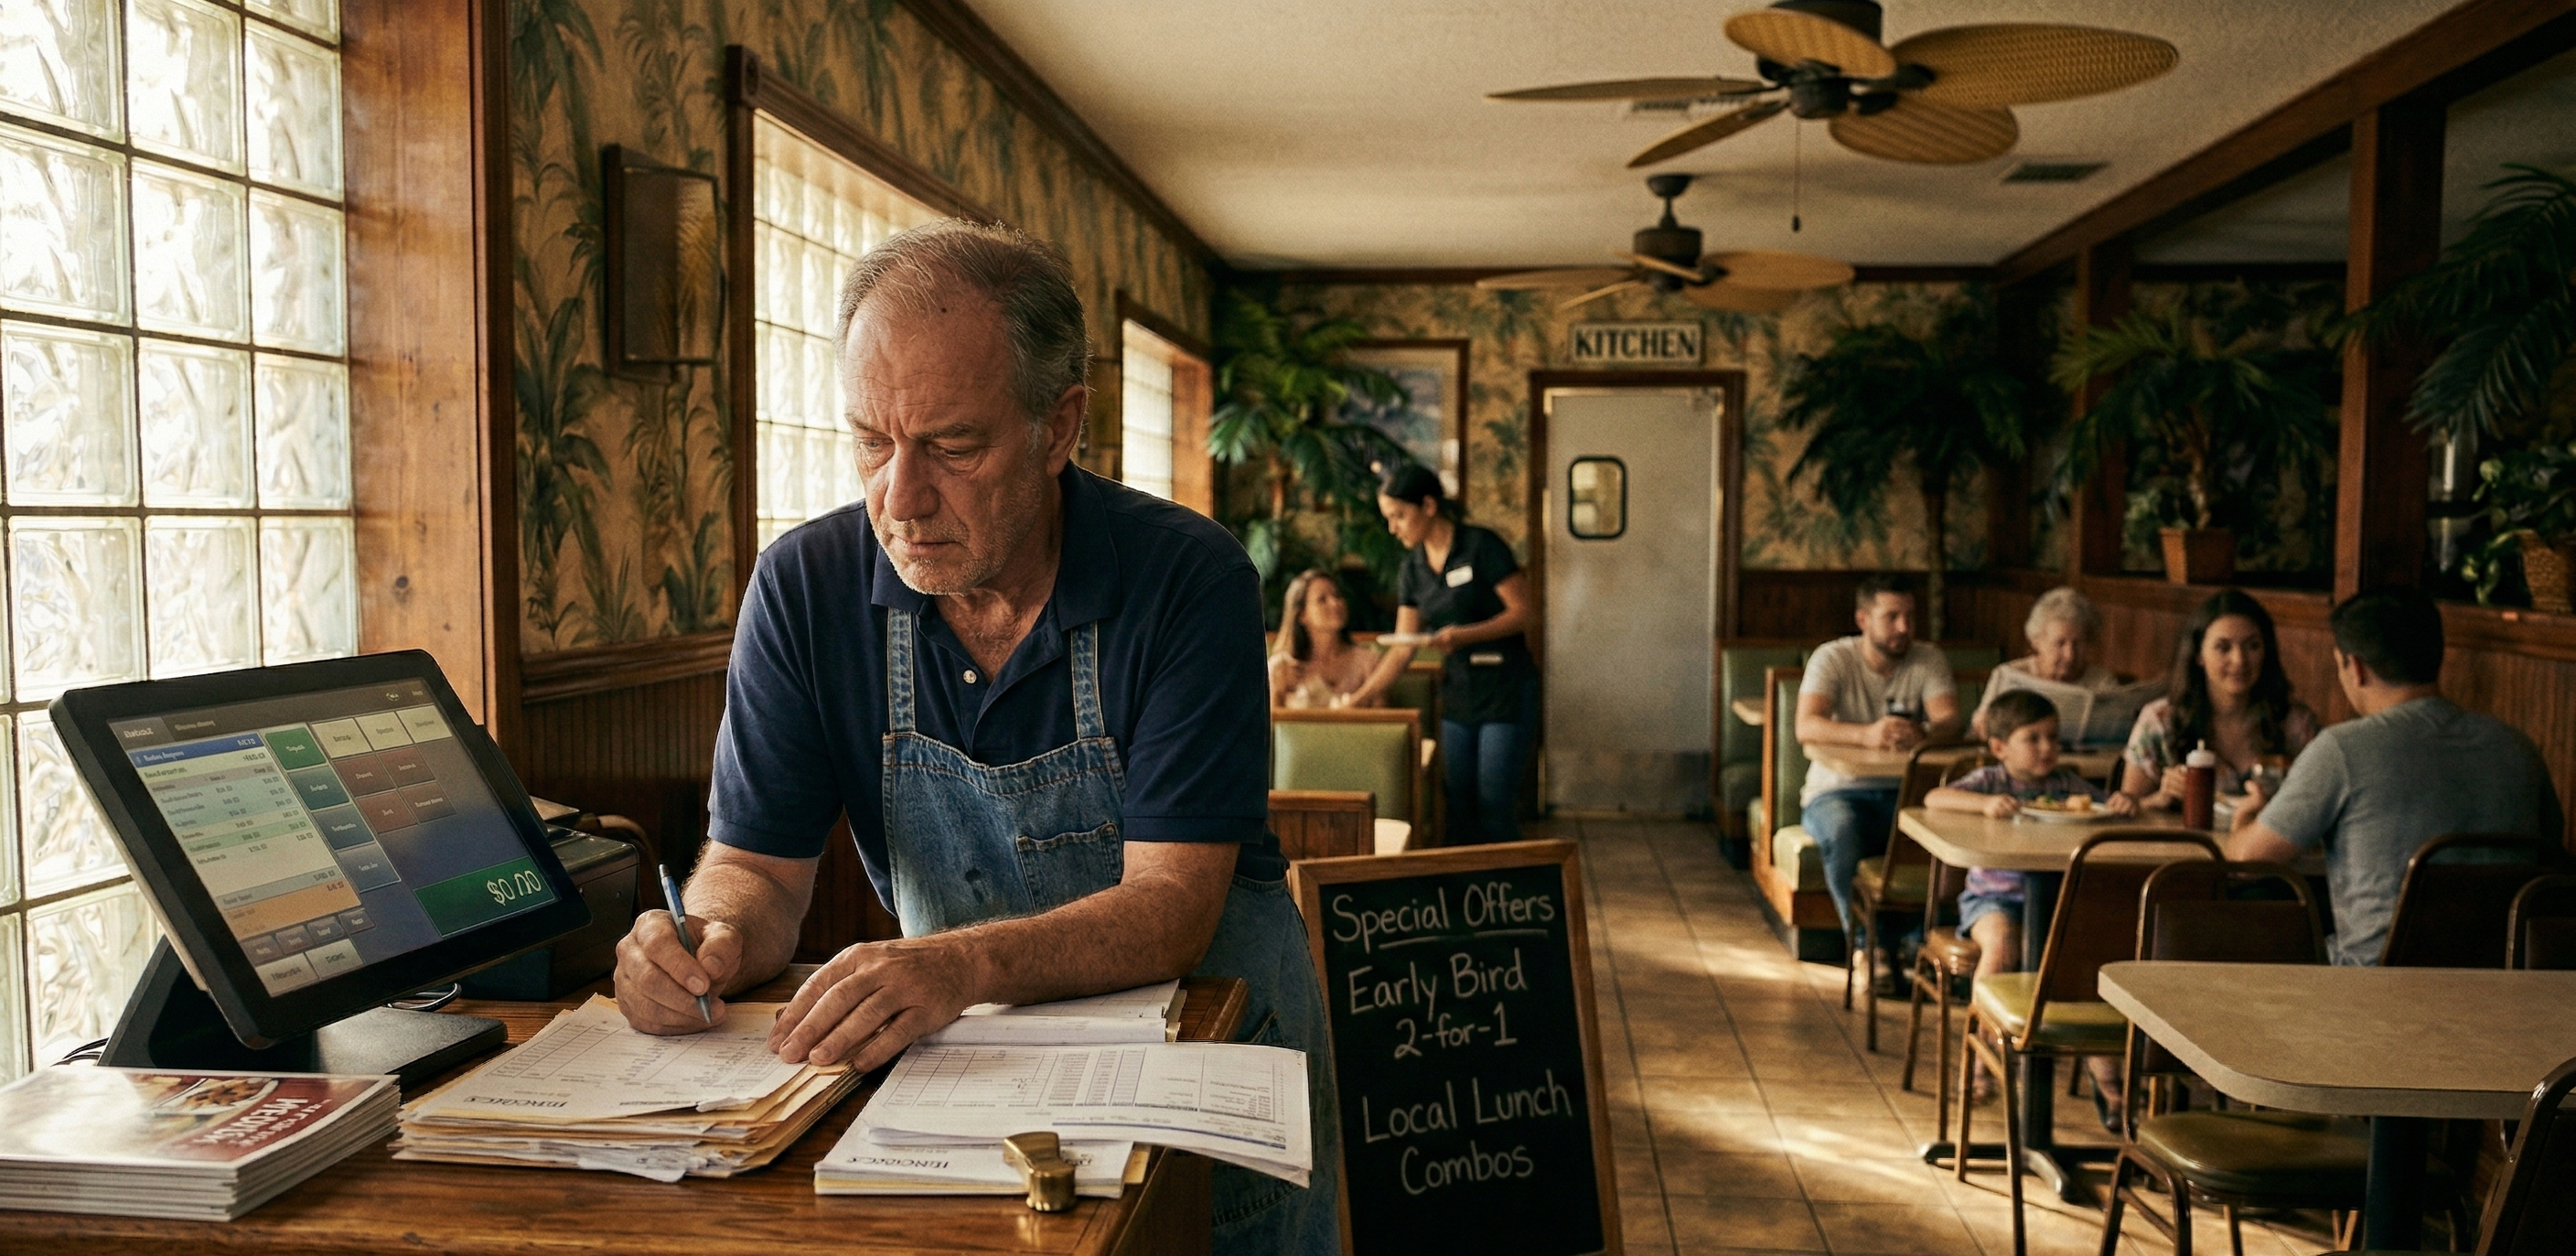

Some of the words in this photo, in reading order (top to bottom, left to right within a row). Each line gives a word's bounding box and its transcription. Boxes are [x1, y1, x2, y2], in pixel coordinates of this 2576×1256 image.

[1575, 329, 1695, 358] KITCHEN
[1332, 886, 1451, 953] Special
[1464, 882, 1555, 929] Offers
[1348, 961, 1438, 1022] Early
[1449, 948, 1528, 998] Bird
[1394, 1002, 1518, 1059] 2-for-1
[1363, 1080, 1459, 1143] Local
[1473, 1068, 1572, 1124] Lunch
[1401, 1140, 1534, 1195] Combos
